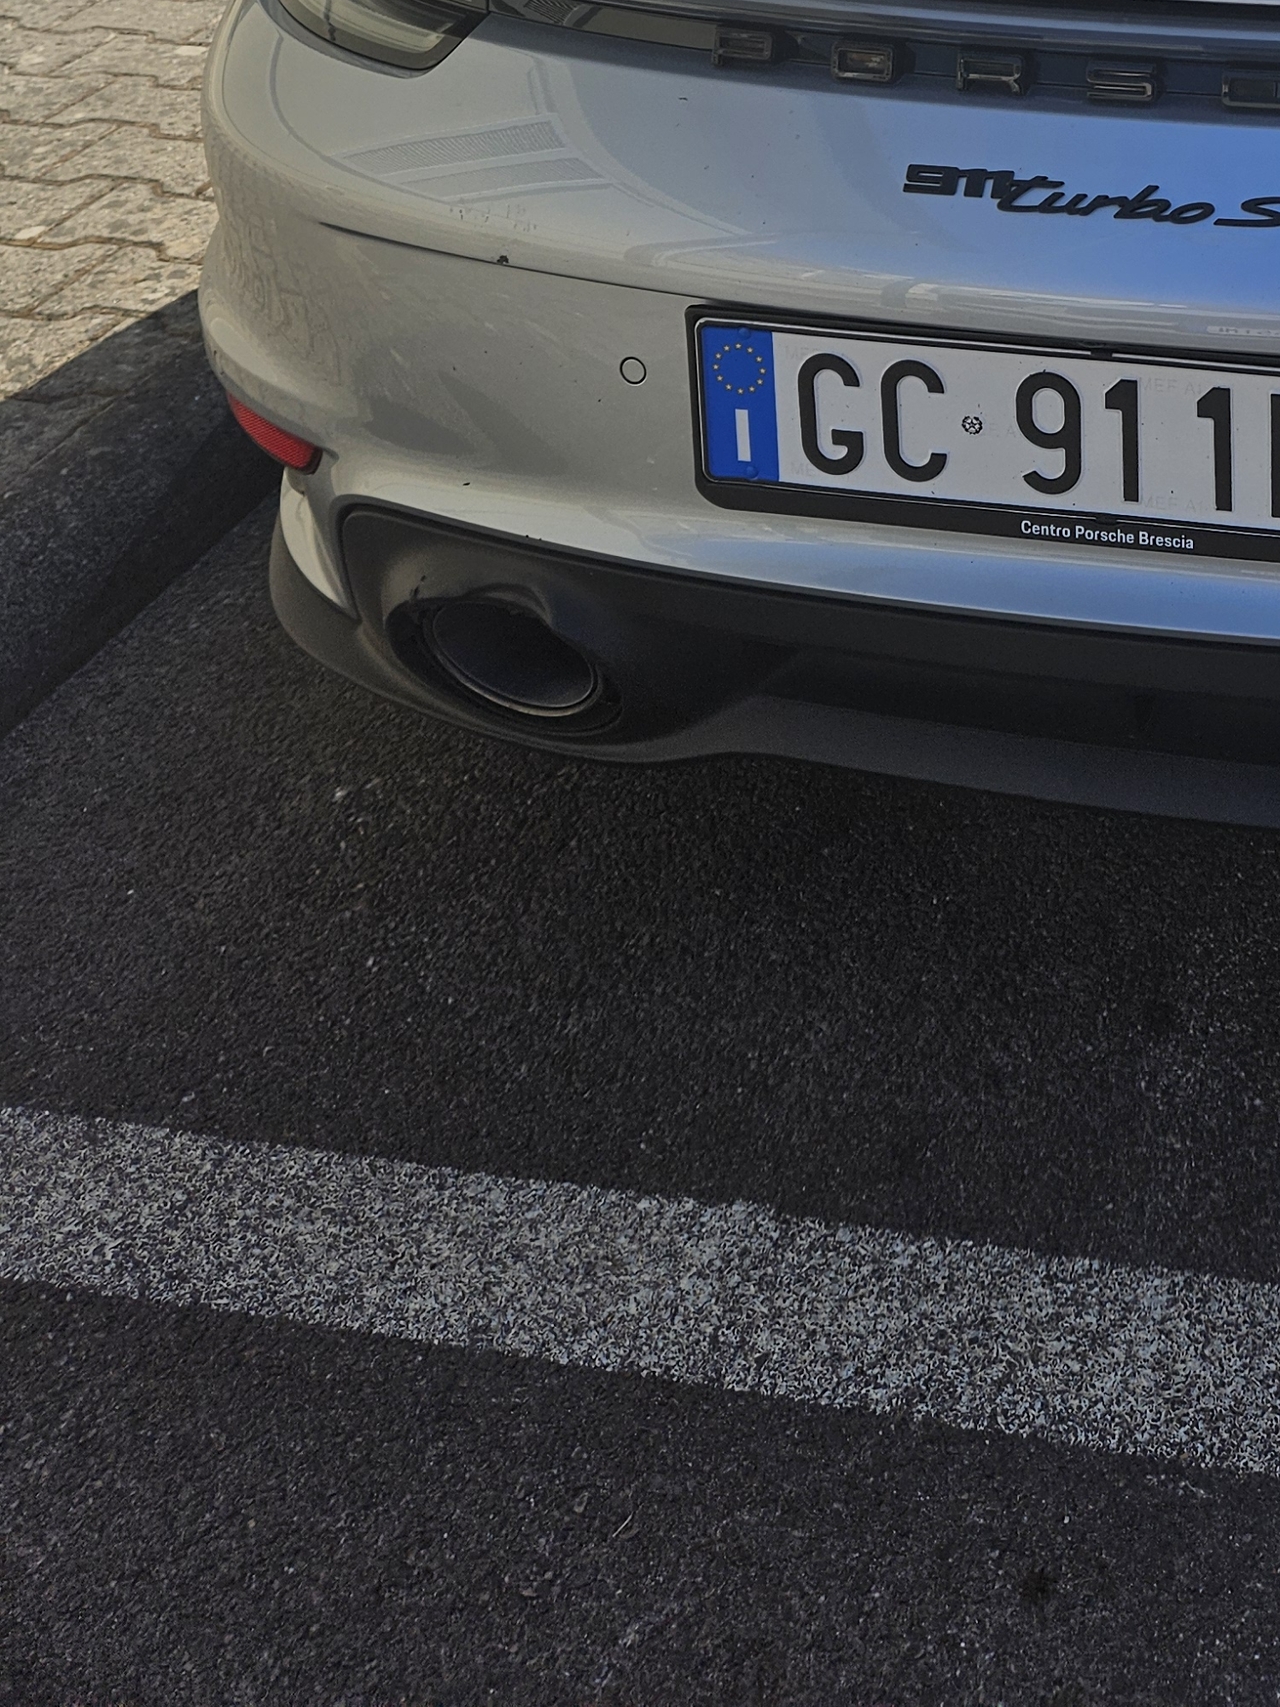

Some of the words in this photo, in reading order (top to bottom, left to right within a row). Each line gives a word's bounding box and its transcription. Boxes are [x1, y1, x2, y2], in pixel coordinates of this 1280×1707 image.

[997, 175, 1215, 225] turbo
[798, 352, 948, 482] GC
[1021, 520, 1071, 538] Centro
[1075, 525, 1135, 544] Porsche
[1139, 530, 1194, 549] Brescia
